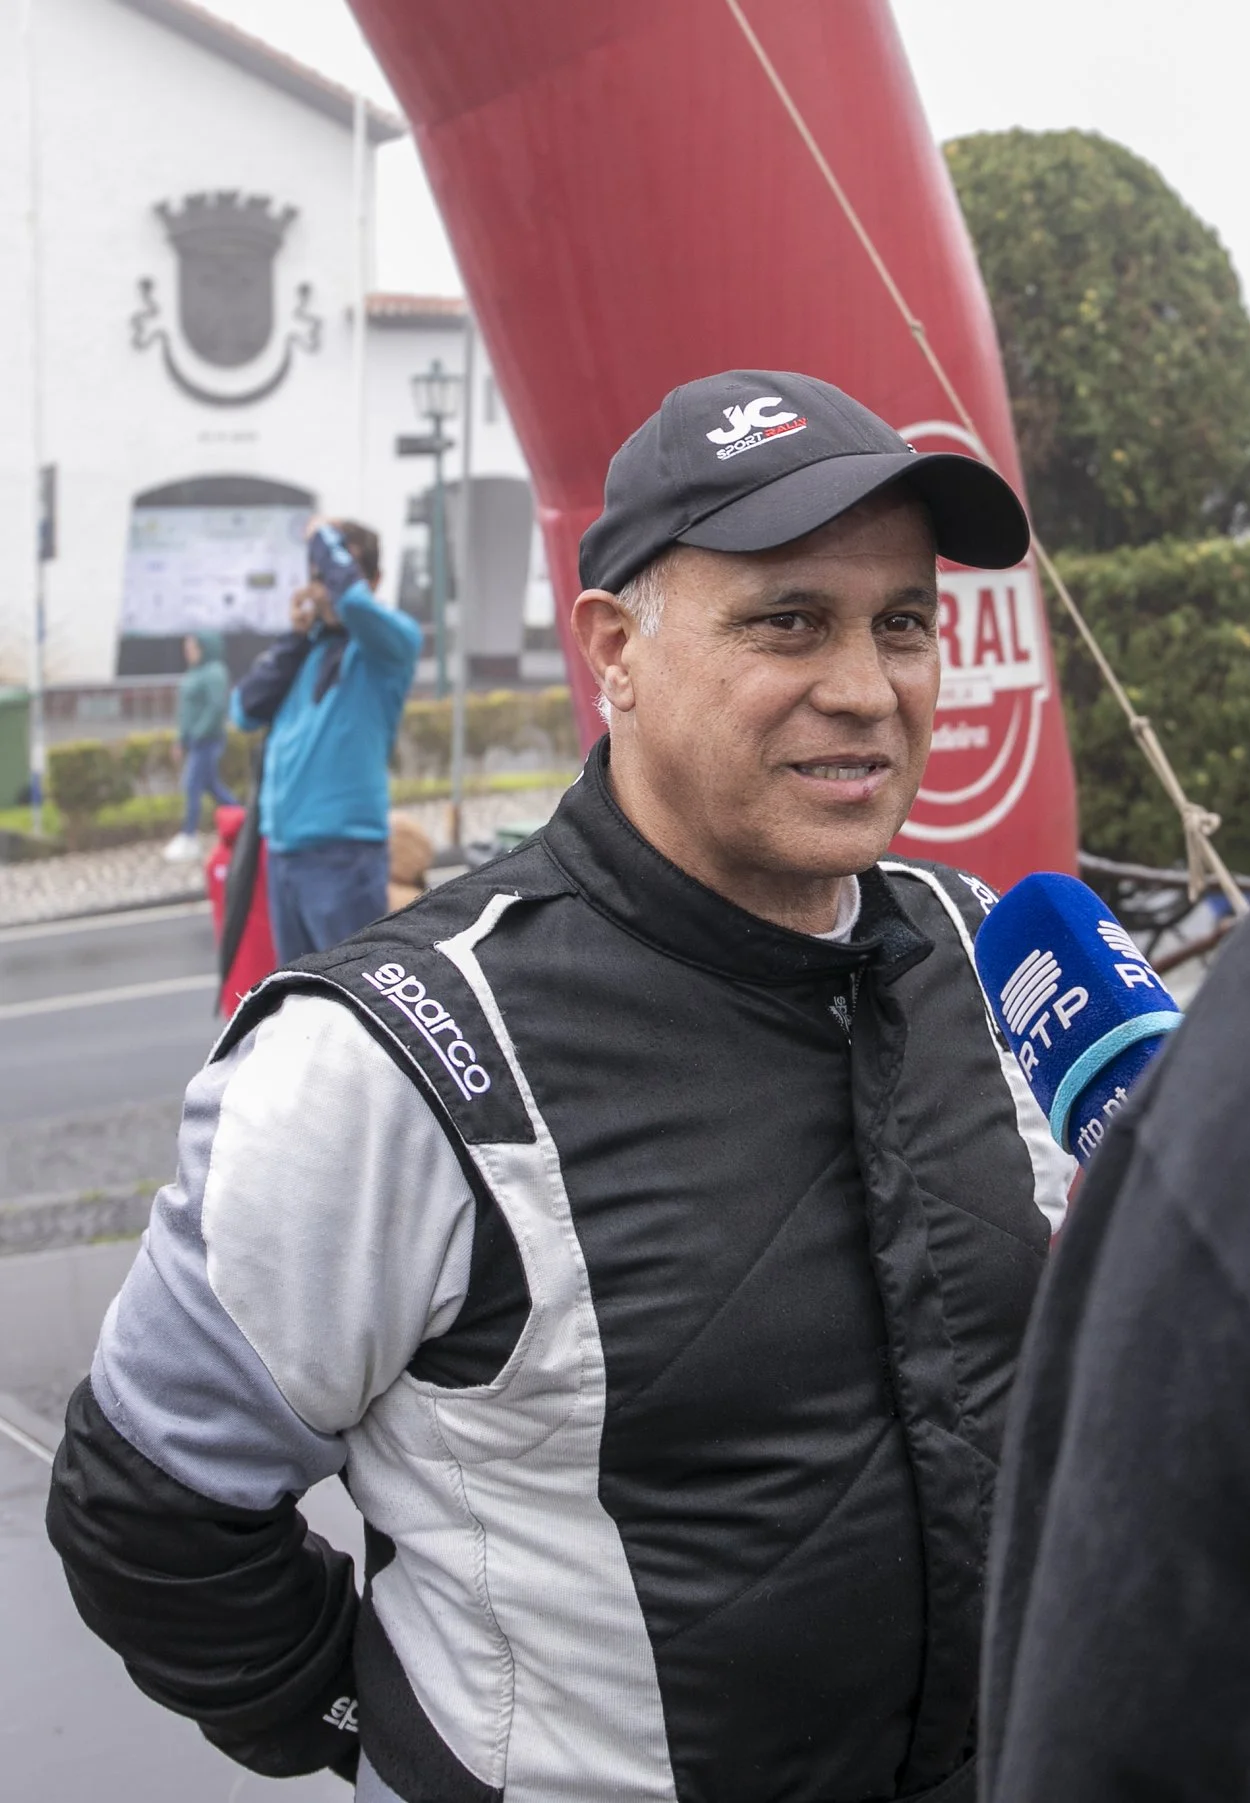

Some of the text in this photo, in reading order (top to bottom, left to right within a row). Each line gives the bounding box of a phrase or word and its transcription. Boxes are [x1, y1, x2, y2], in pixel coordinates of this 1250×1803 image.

[706, 397, 798, 445] JC
[716, 417, 808, 460] SPORT RALLY
[938, 586, 1031, 668] RAL
[373, 962, 492, 1095] sparco
[1018, 986, 1090, 1082] RTP
